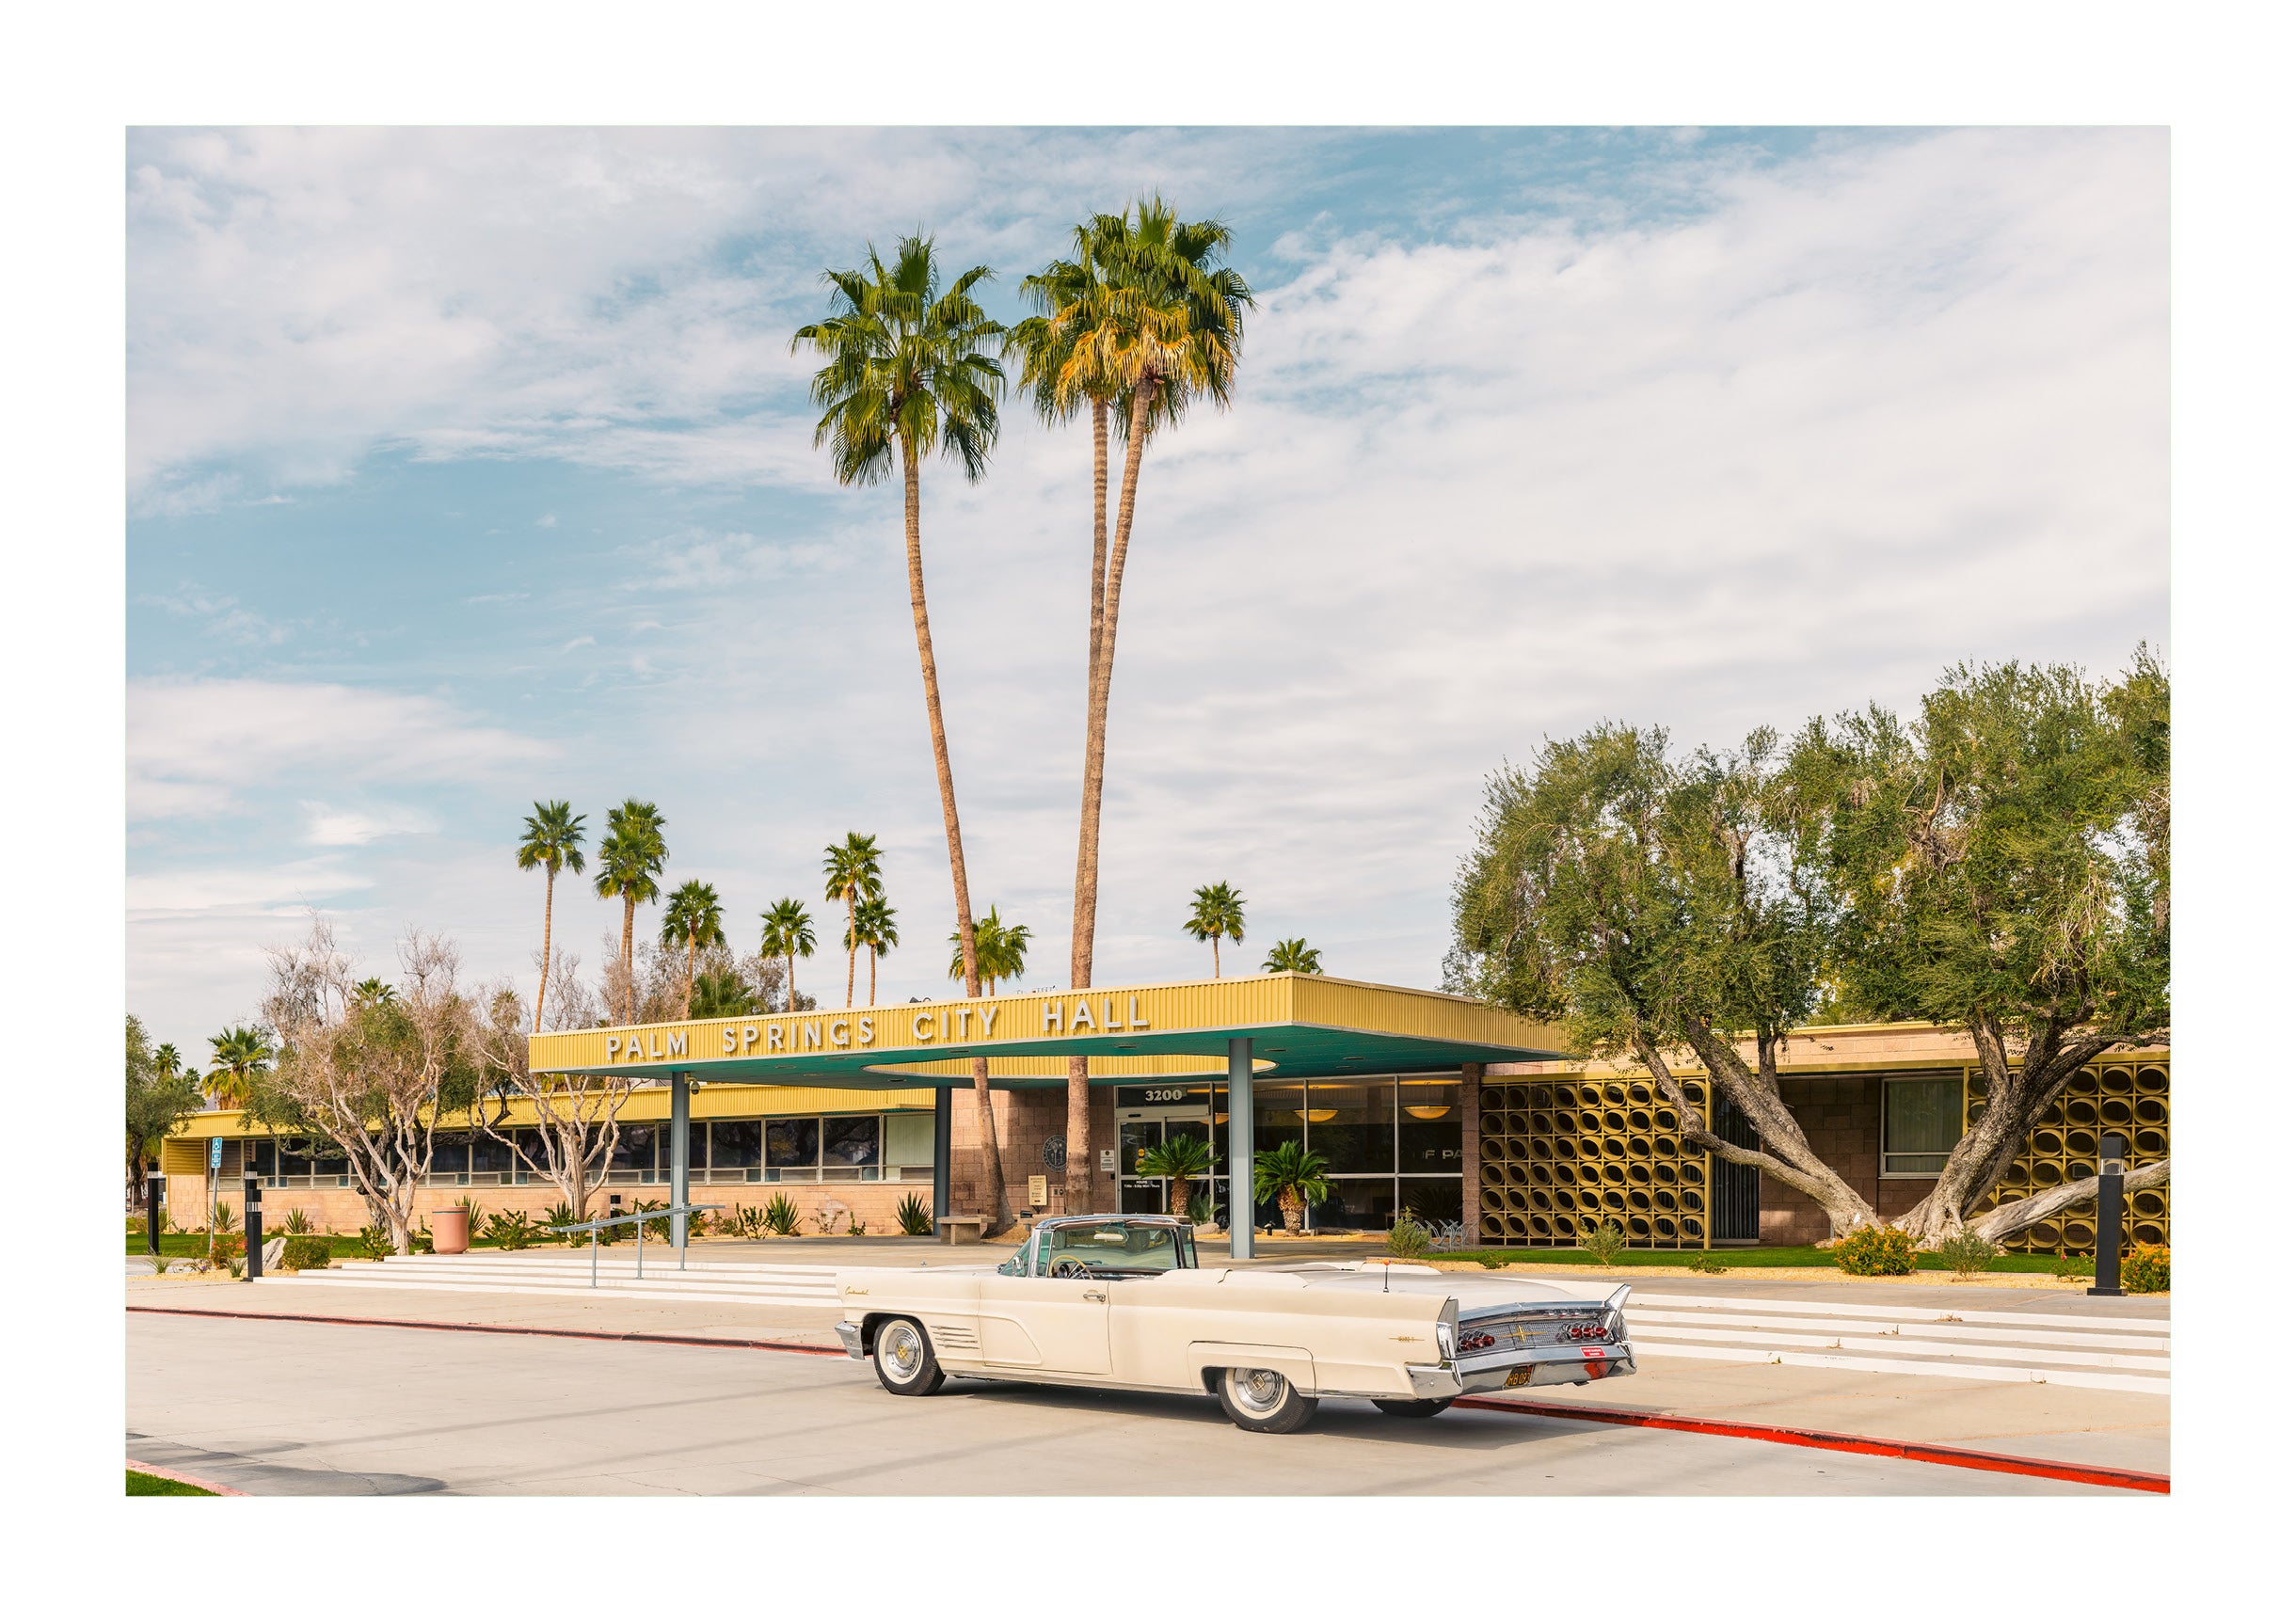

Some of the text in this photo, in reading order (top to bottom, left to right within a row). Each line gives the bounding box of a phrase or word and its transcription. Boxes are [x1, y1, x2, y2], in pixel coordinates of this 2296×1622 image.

[606, 995, 1150, 1060] PALM SPRINGS CITY HALL
[1145, 1089, 1183, 1102] 3200
